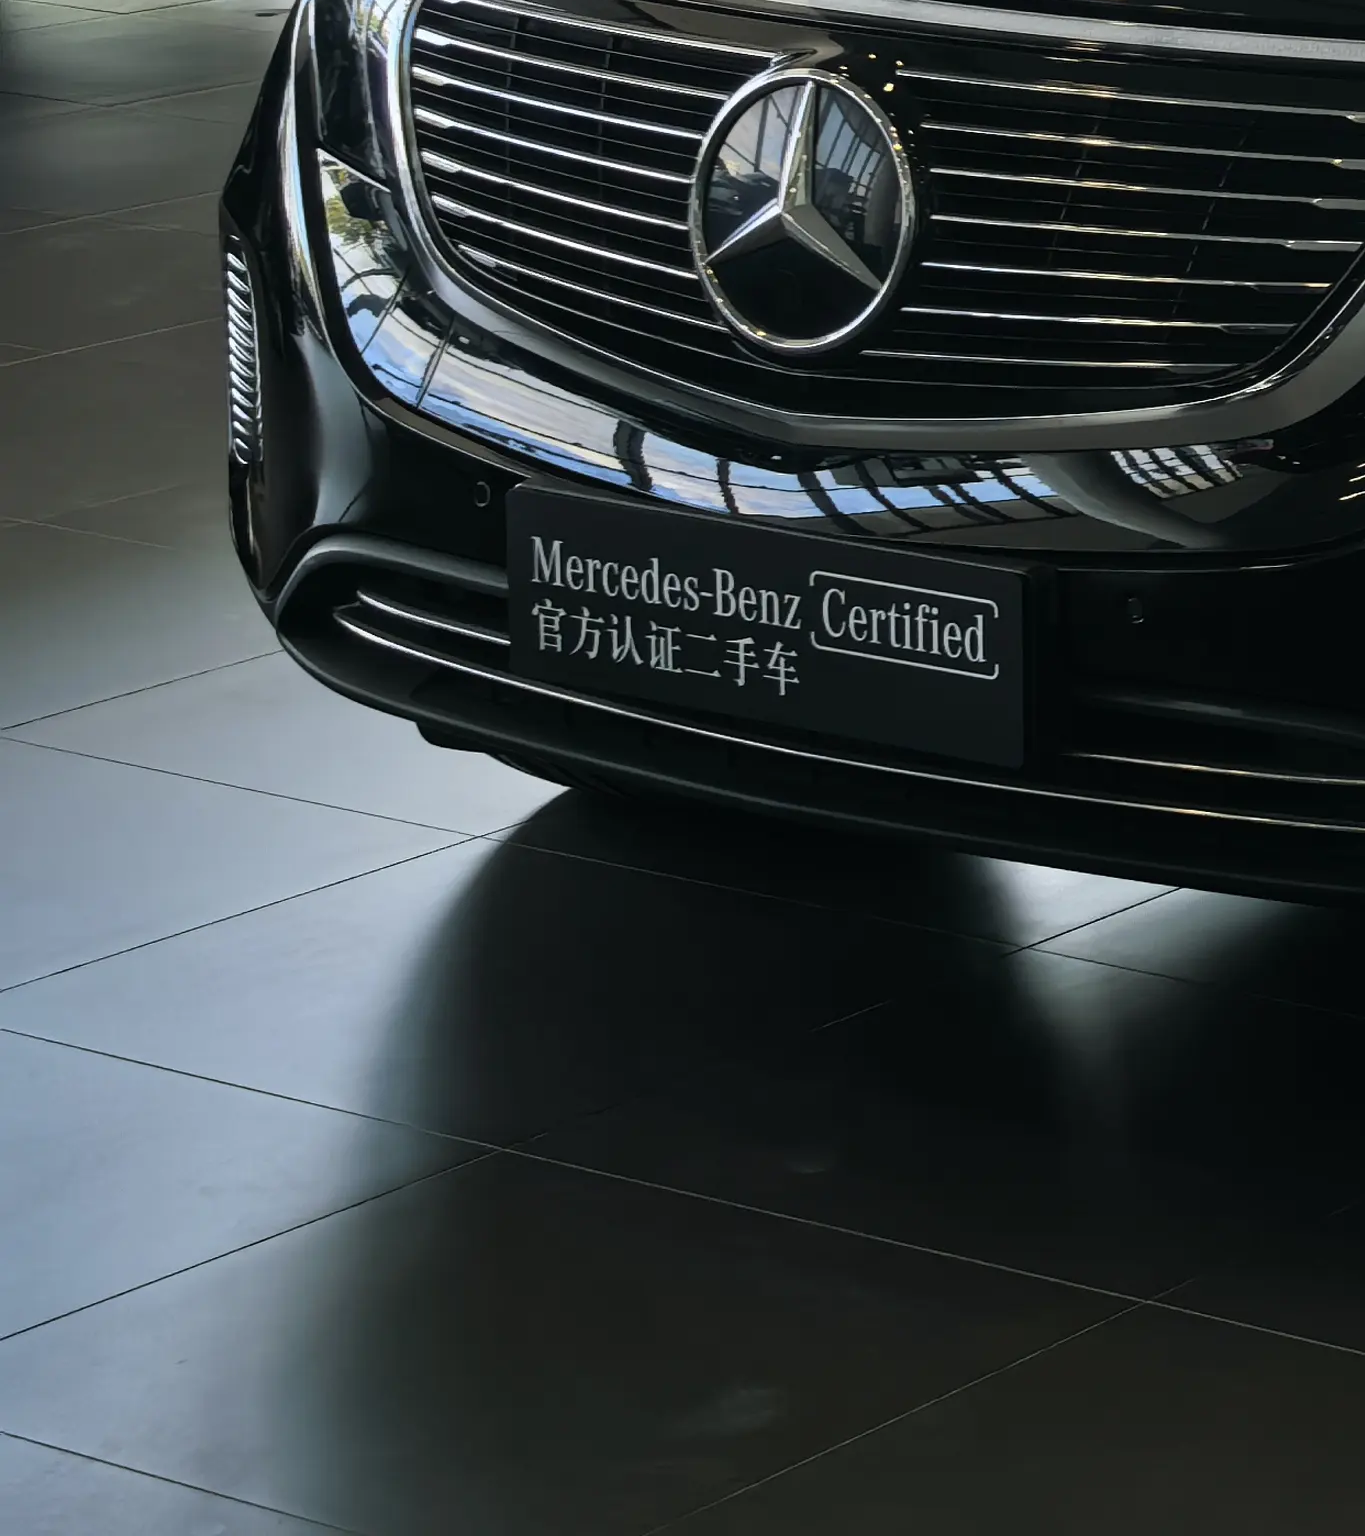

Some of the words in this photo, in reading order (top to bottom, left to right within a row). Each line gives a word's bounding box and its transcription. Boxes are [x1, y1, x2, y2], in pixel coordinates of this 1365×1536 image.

[530, 536, 802, 630] Mercedes-Benz
[822, 587, 987, 663] Certified
[531, 598, 800, 696] 官方认证二手车
